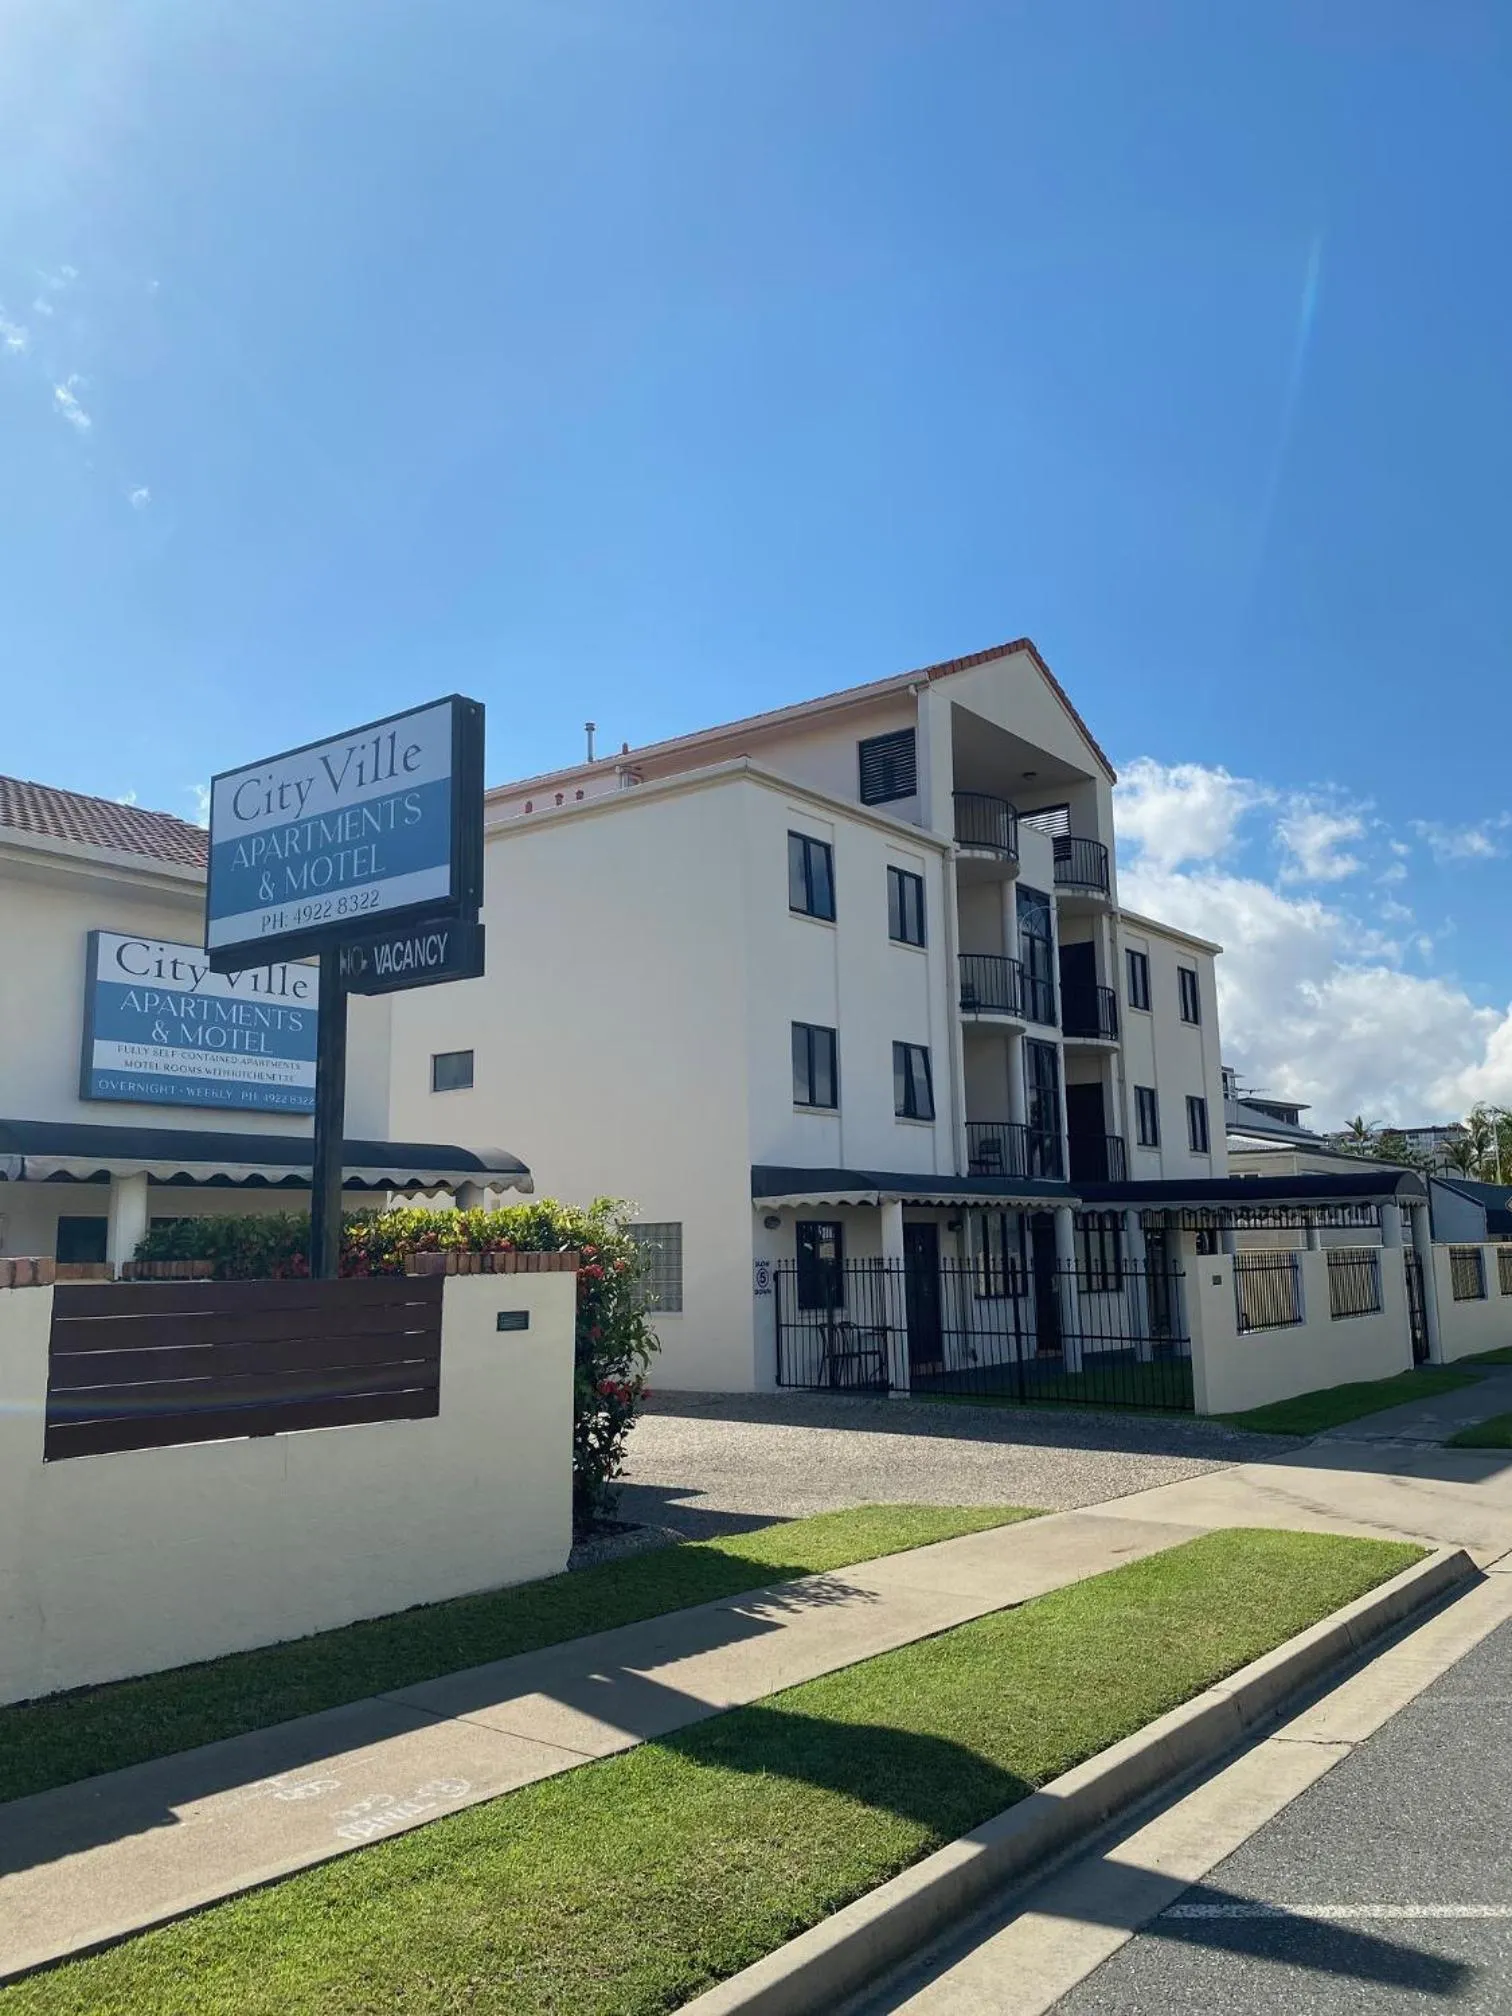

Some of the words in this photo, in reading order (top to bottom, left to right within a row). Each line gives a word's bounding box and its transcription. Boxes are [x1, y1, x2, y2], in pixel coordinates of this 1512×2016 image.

[233, 775, 314, 820] City
[320, 731, 421, 794] Ville
[230, 791, 423, 873] APARTMENTS
[258, 870, 276, 901] &
[285, 844, 385, 896] MOTEL
[261, 911, 288, 933] PH:
[294, 901, 333, 925] 4922
[337, 889, 380, 915] 8322
[116, 942, 209, 992] City
[373, 932, 448, 976] VACANCY
[120, 990, 304, 1032] APARTMENTS
[151, 1019, 171, 1045] &
[181, 1023, 274, 1054] MOTEL
[98, 1079, 175, 1096] OVERNIGHT
[186, 1086, 233, 1100] WEEKLY
[124, 1060, 159, 1071] MOTEL
[163, 1064, 203, 1075] ROOMS
[760, 1272, 766, 1283] 5
